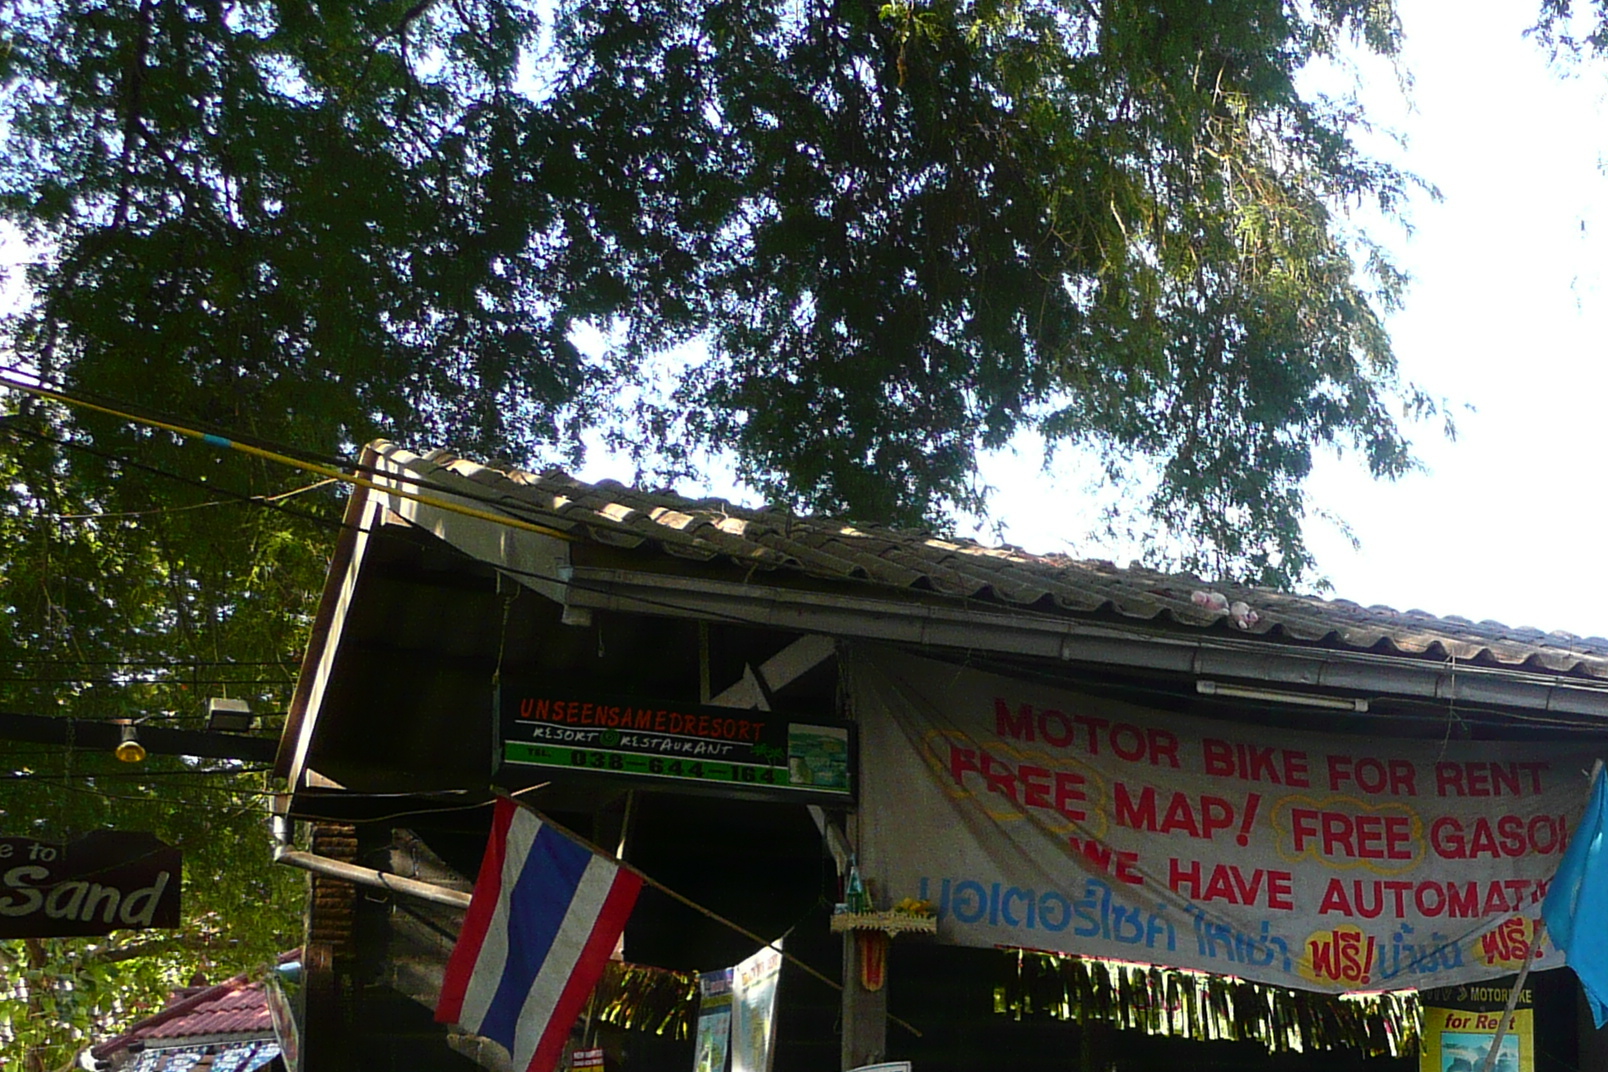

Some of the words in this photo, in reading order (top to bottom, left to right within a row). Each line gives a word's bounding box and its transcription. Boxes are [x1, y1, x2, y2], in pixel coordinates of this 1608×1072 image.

[519, 699, 766, 741] UNSEENSAMEDRESORT
[533, 727, 600, 743] RESORT
[619, 734, 734, 756] RESTAURANT
[527, 746, 552, 759] TEL.
[570, 751, 776, 785] 038-644-164
[993, 697, 1180, 769] MOTOR
[1202, 737, 1310, 788] BIKE
[1326, 754, 1417, 796] FOR
[1435, 761, 1550, 797] RENT
[949, 743, 1086, 821] FREE
[1113, 781, 1261, 848] MAP!
[1291, 807, 1412, 859] FREE
[27, 842, 58, 862] to
[1067, 836, 1144, 885] WE
[1168, 857, 1294, 911] HAVE
[0, 865, 170, 927] Sand
[1310, 929, 1375, 985] ฟรี!
[1445, 1013, 1471, 1029] for
[1474, 1014, 1516, 1031] Ret
